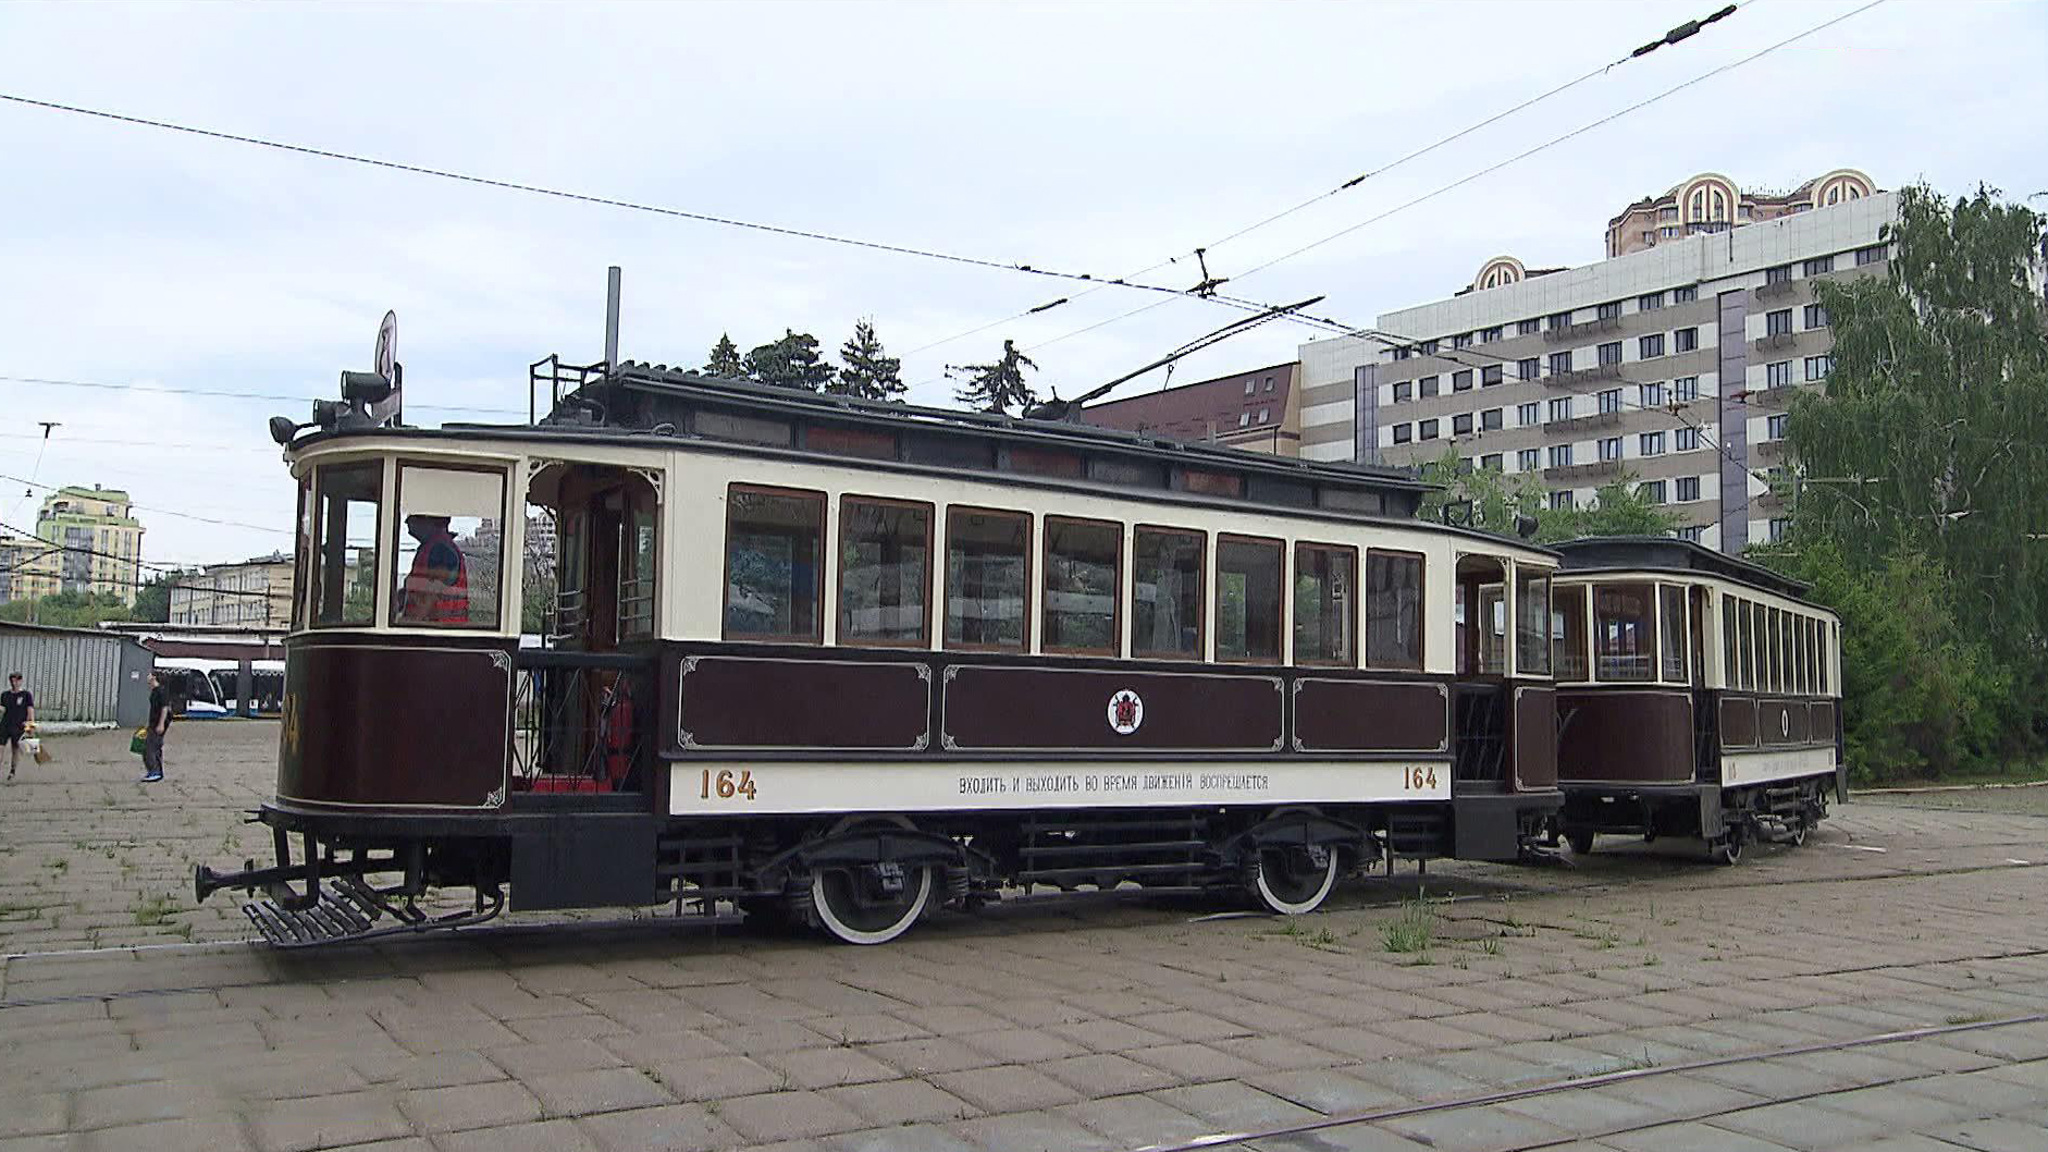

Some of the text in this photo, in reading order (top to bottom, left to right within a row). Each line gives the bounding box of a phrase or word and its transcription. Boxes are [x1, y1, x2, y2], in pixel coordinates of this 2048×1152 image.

[701, 769, 757, 800] 164
[959, 777, 1006, 793] ВХОДИТЬ
[1011, 777, 1020, 792] И
[1025, 775, 1078, 792] ВЫХОДИТЬ
[1085, 775, 1097, 791] ВО
[1104, 774, 1138, 790] ВРЕМЯ
[1199, 774, 1269, 789] ВОСПРЕЩАЕТСЯ
[1405, 766, 1436, 789] 164
